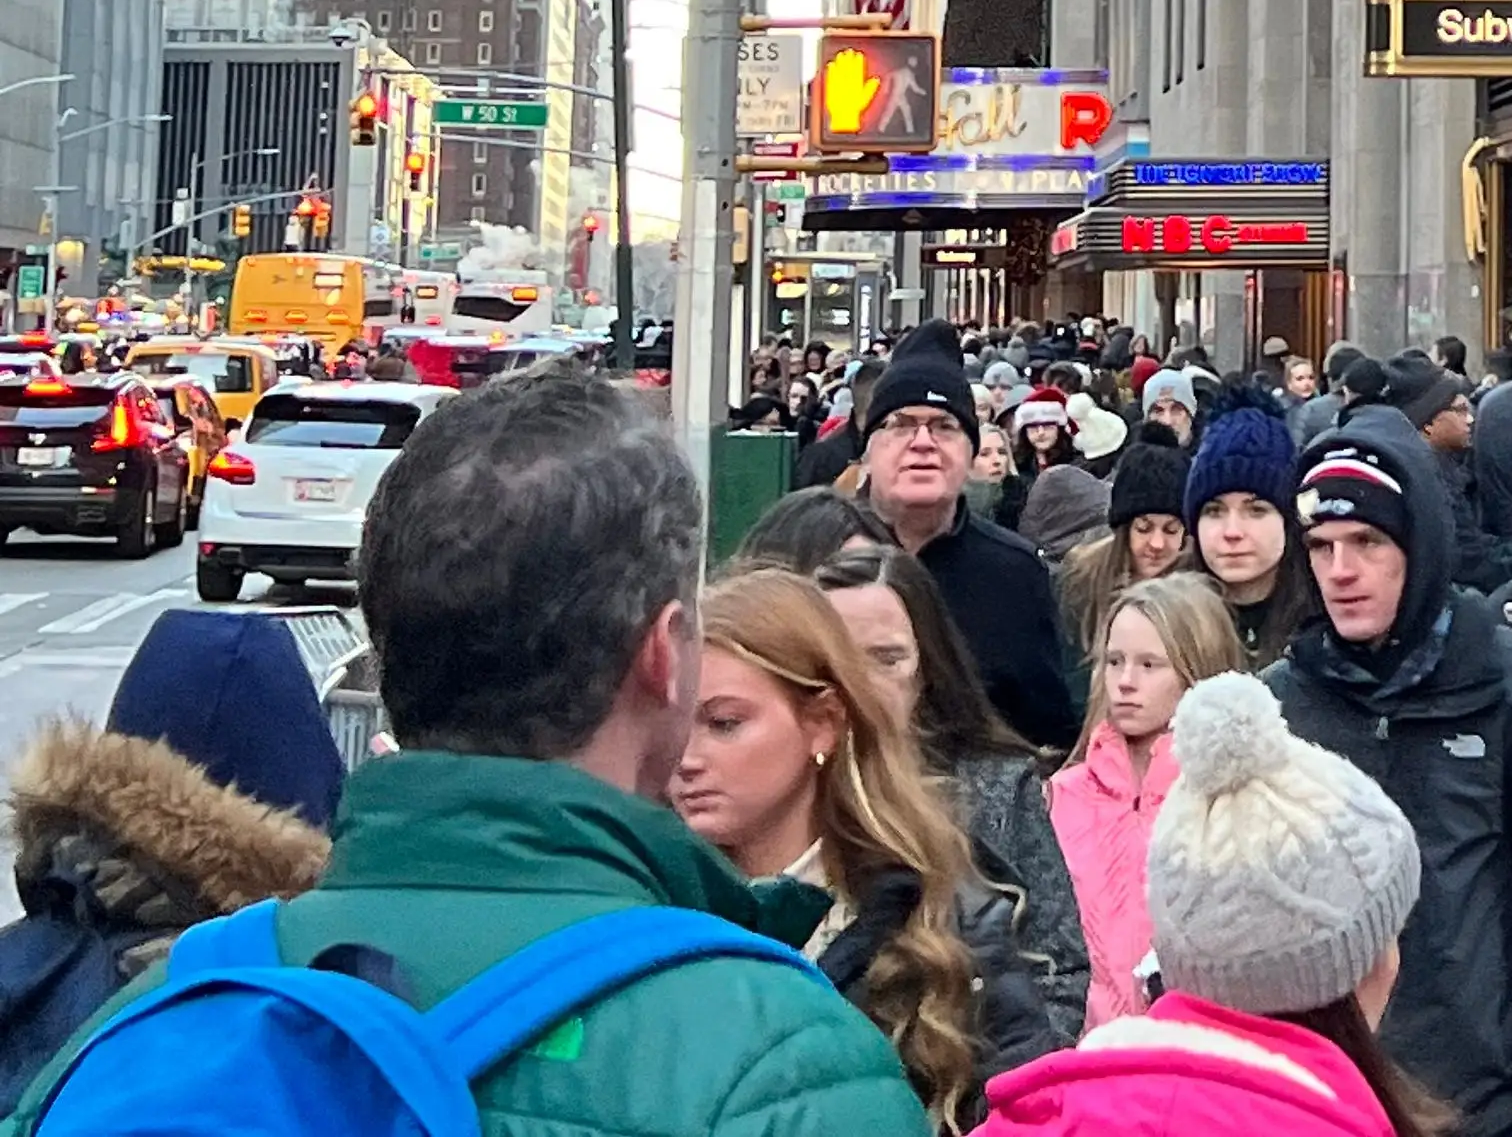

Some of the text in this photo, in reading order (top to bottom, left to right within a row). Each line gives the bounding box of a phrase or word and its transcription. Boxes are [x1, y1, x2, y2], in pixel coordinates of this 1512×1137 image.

[461, 105, 475, 121] W
[478, 106, 498, 122] 50
[1121, 214, 1233, 255] NBC
